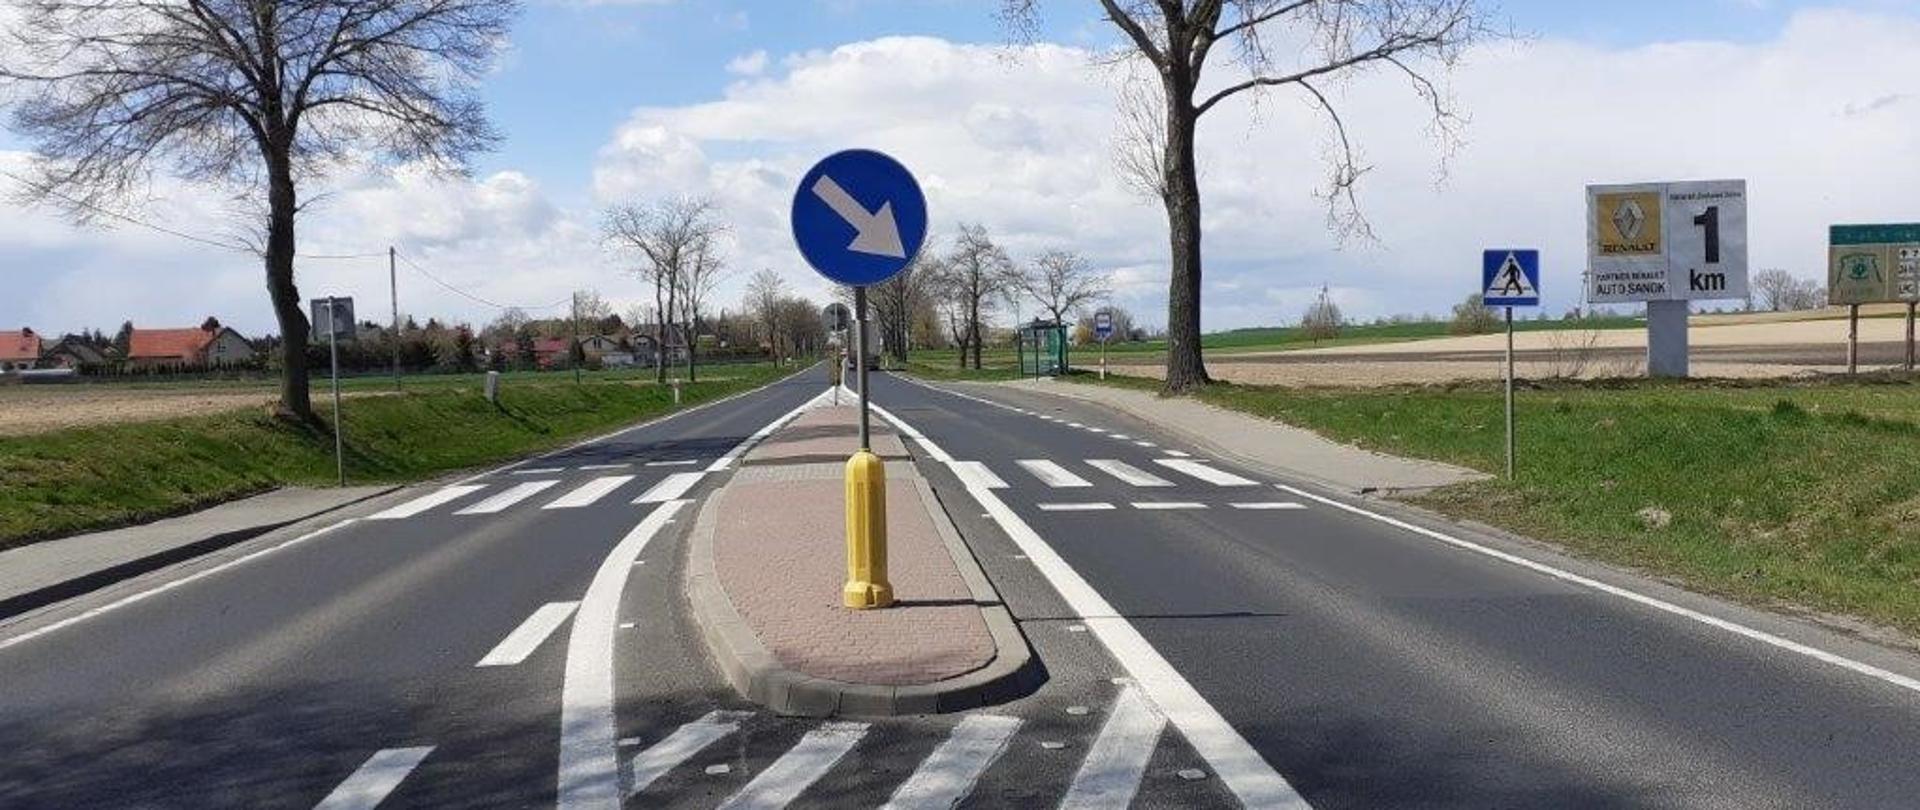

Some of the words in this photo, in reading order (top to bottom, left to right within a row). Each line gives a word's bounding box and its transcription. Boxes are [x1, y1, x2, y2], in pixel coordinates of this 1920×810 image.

[1694, 206, 1719, 264] 1
[1603, 243, 1655, 253] RENAULT
[1690, 268, 1725, 291] km
[1597, 284, 1626, 295] AUTO
